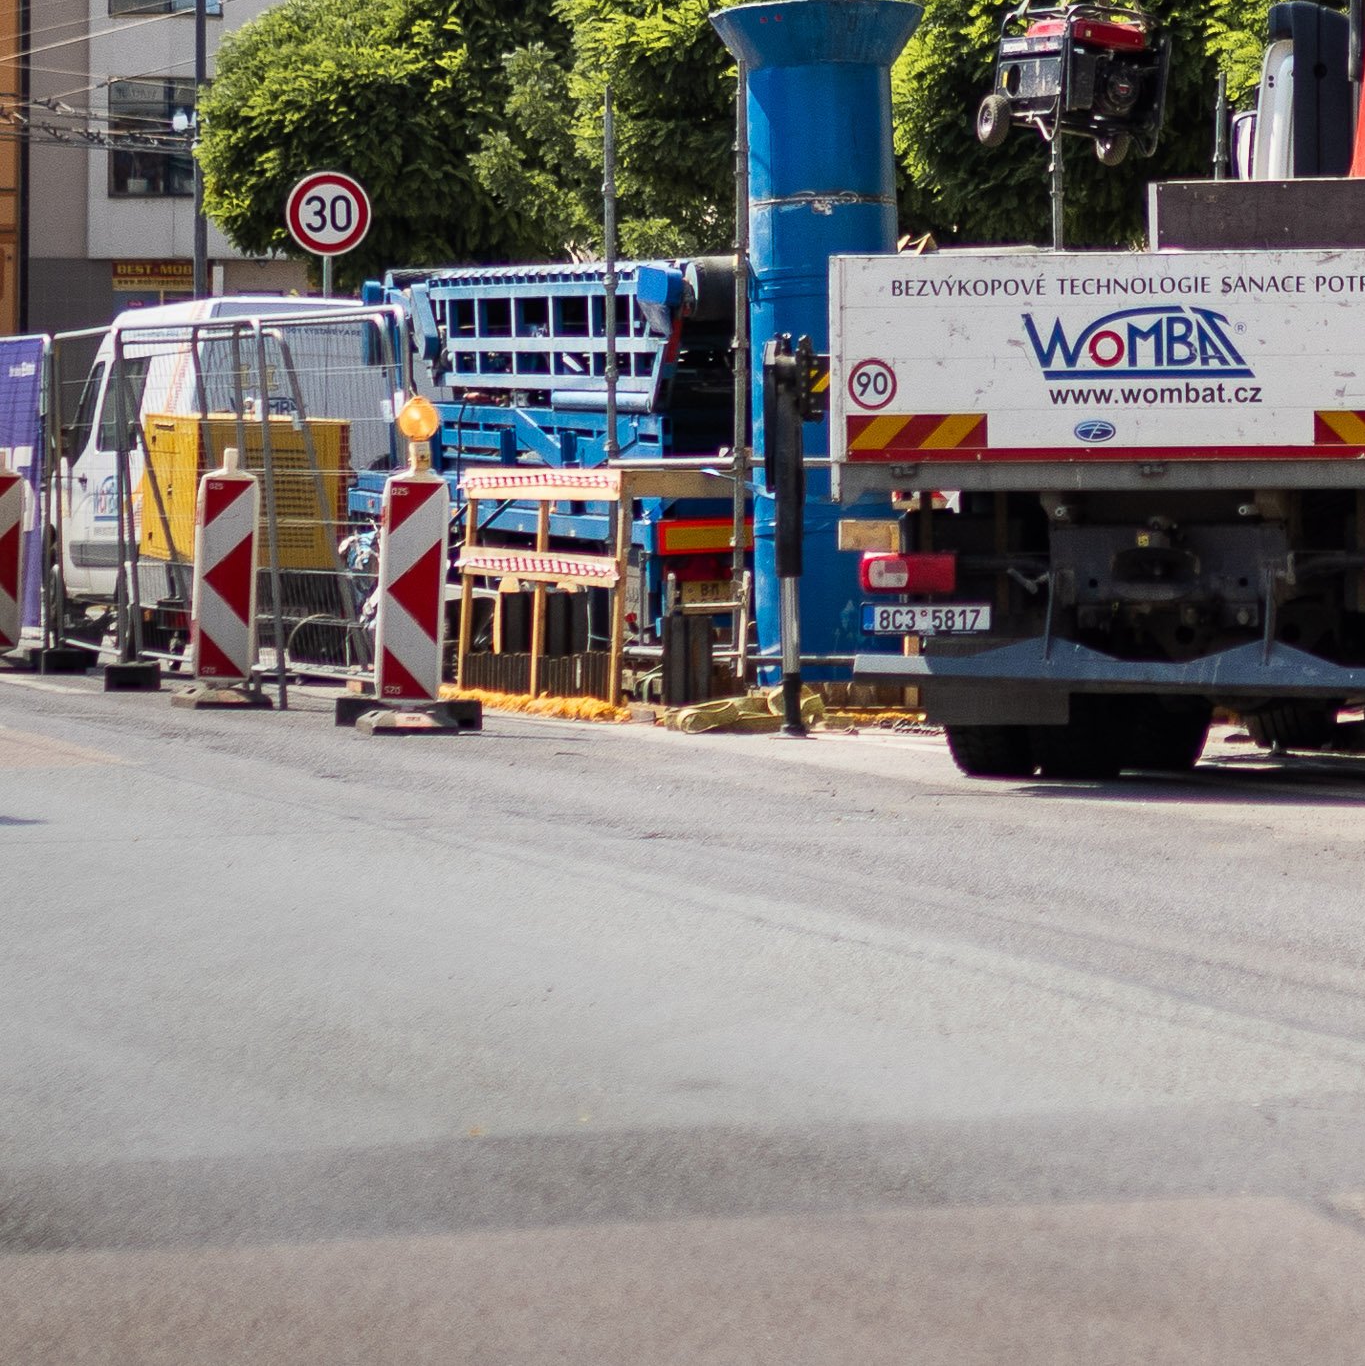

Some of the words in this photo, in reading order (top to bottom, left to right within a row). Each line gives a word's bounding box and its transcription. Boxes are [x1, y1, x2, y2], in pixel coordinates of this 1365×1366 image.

[305, 195, 352, 233] 30
[117, 264, 151, 275] BEST
[160, 264, 193, 275] MOB
[891, 273, 1047, 297] BEZVÝKOPOVÉ
[1056, 276, 1211, 296] TECHNOLOGIE
[1221, 276, 1306, 294] SANACE
[1021, 306, 1248, 368] WOMBAT
[857, 371, 888, 397] 90
[1050, 382, 1263, 405] www.wombat.cz
[879, 609, 916, 630] 8C3
[931, 609, 980, 631] 5817
